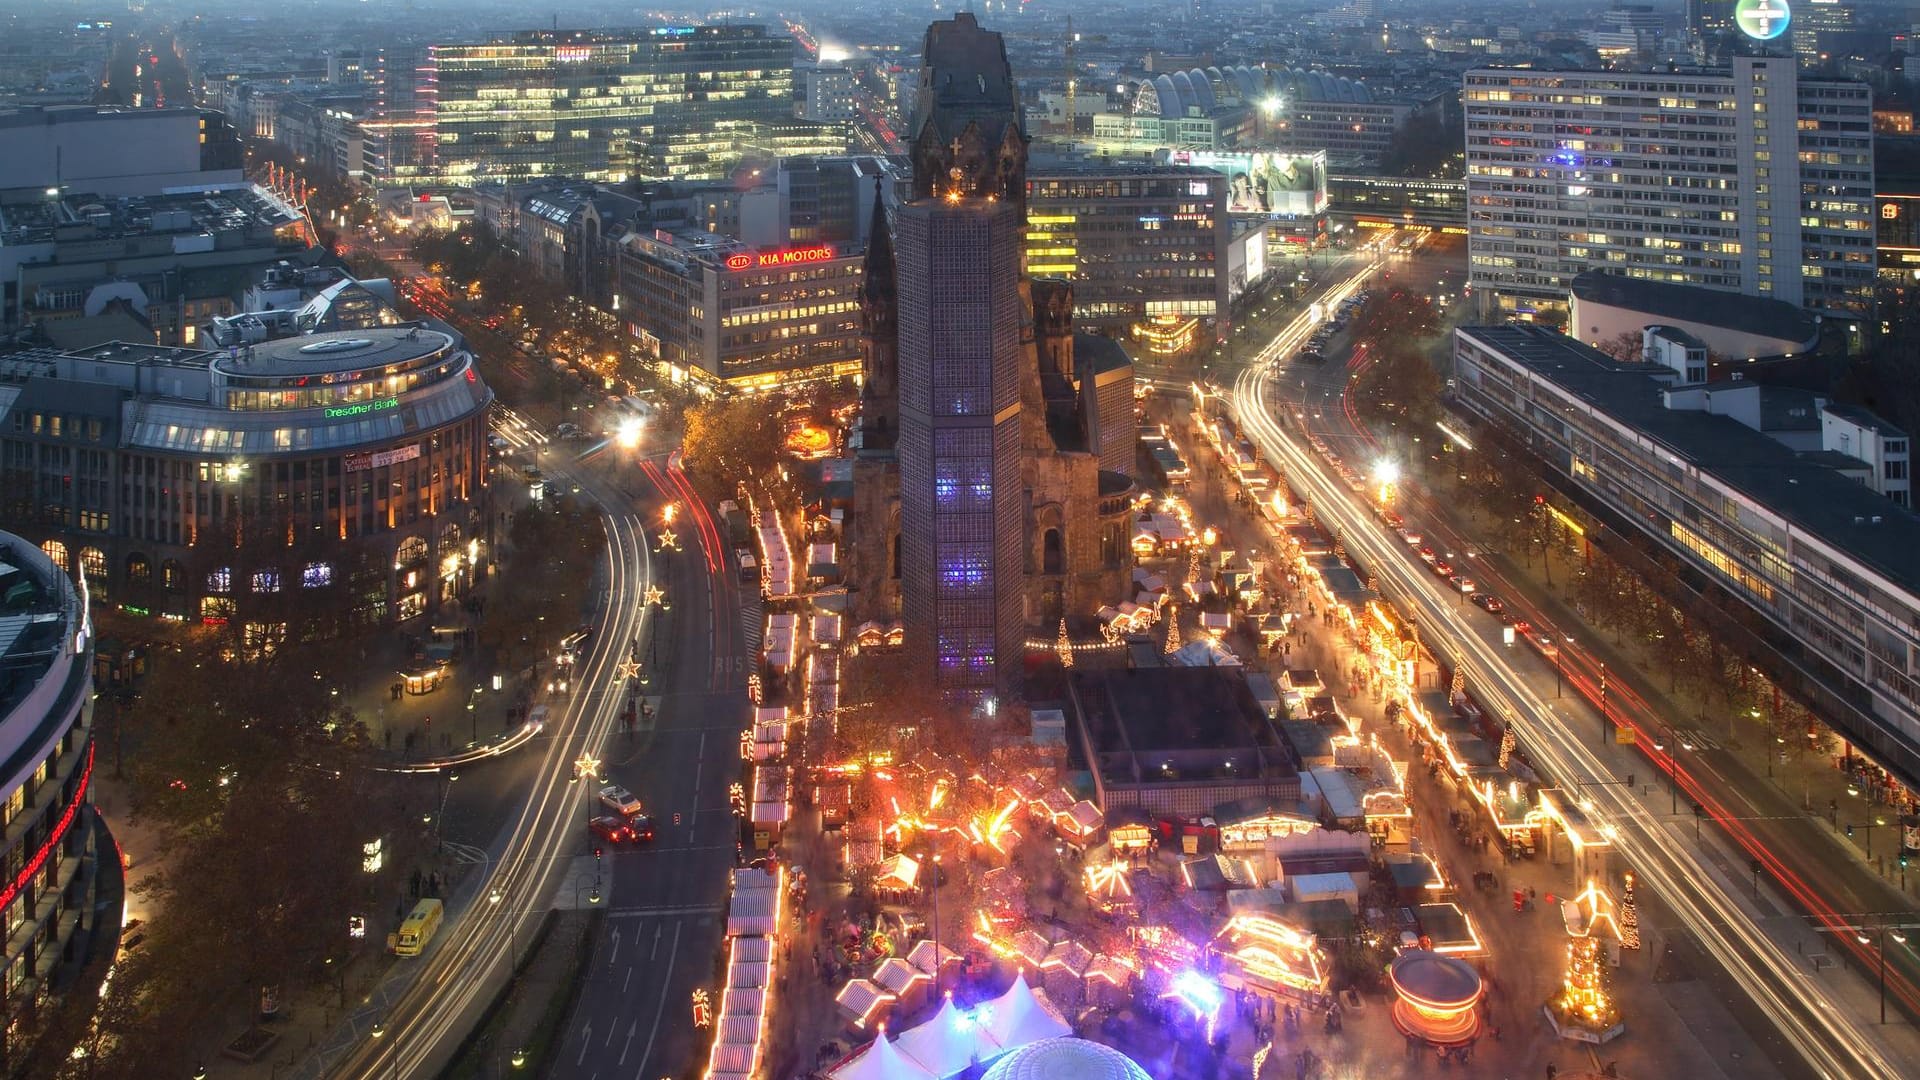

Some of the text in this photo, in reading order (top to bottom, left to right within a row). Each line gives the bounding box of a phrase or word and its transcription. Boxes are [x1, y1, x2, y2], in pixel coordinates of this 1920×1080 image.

[730, 248, 832, 268] KIA KIA MOTORS
[325, 397, 399, 418] Dresdner Bank
